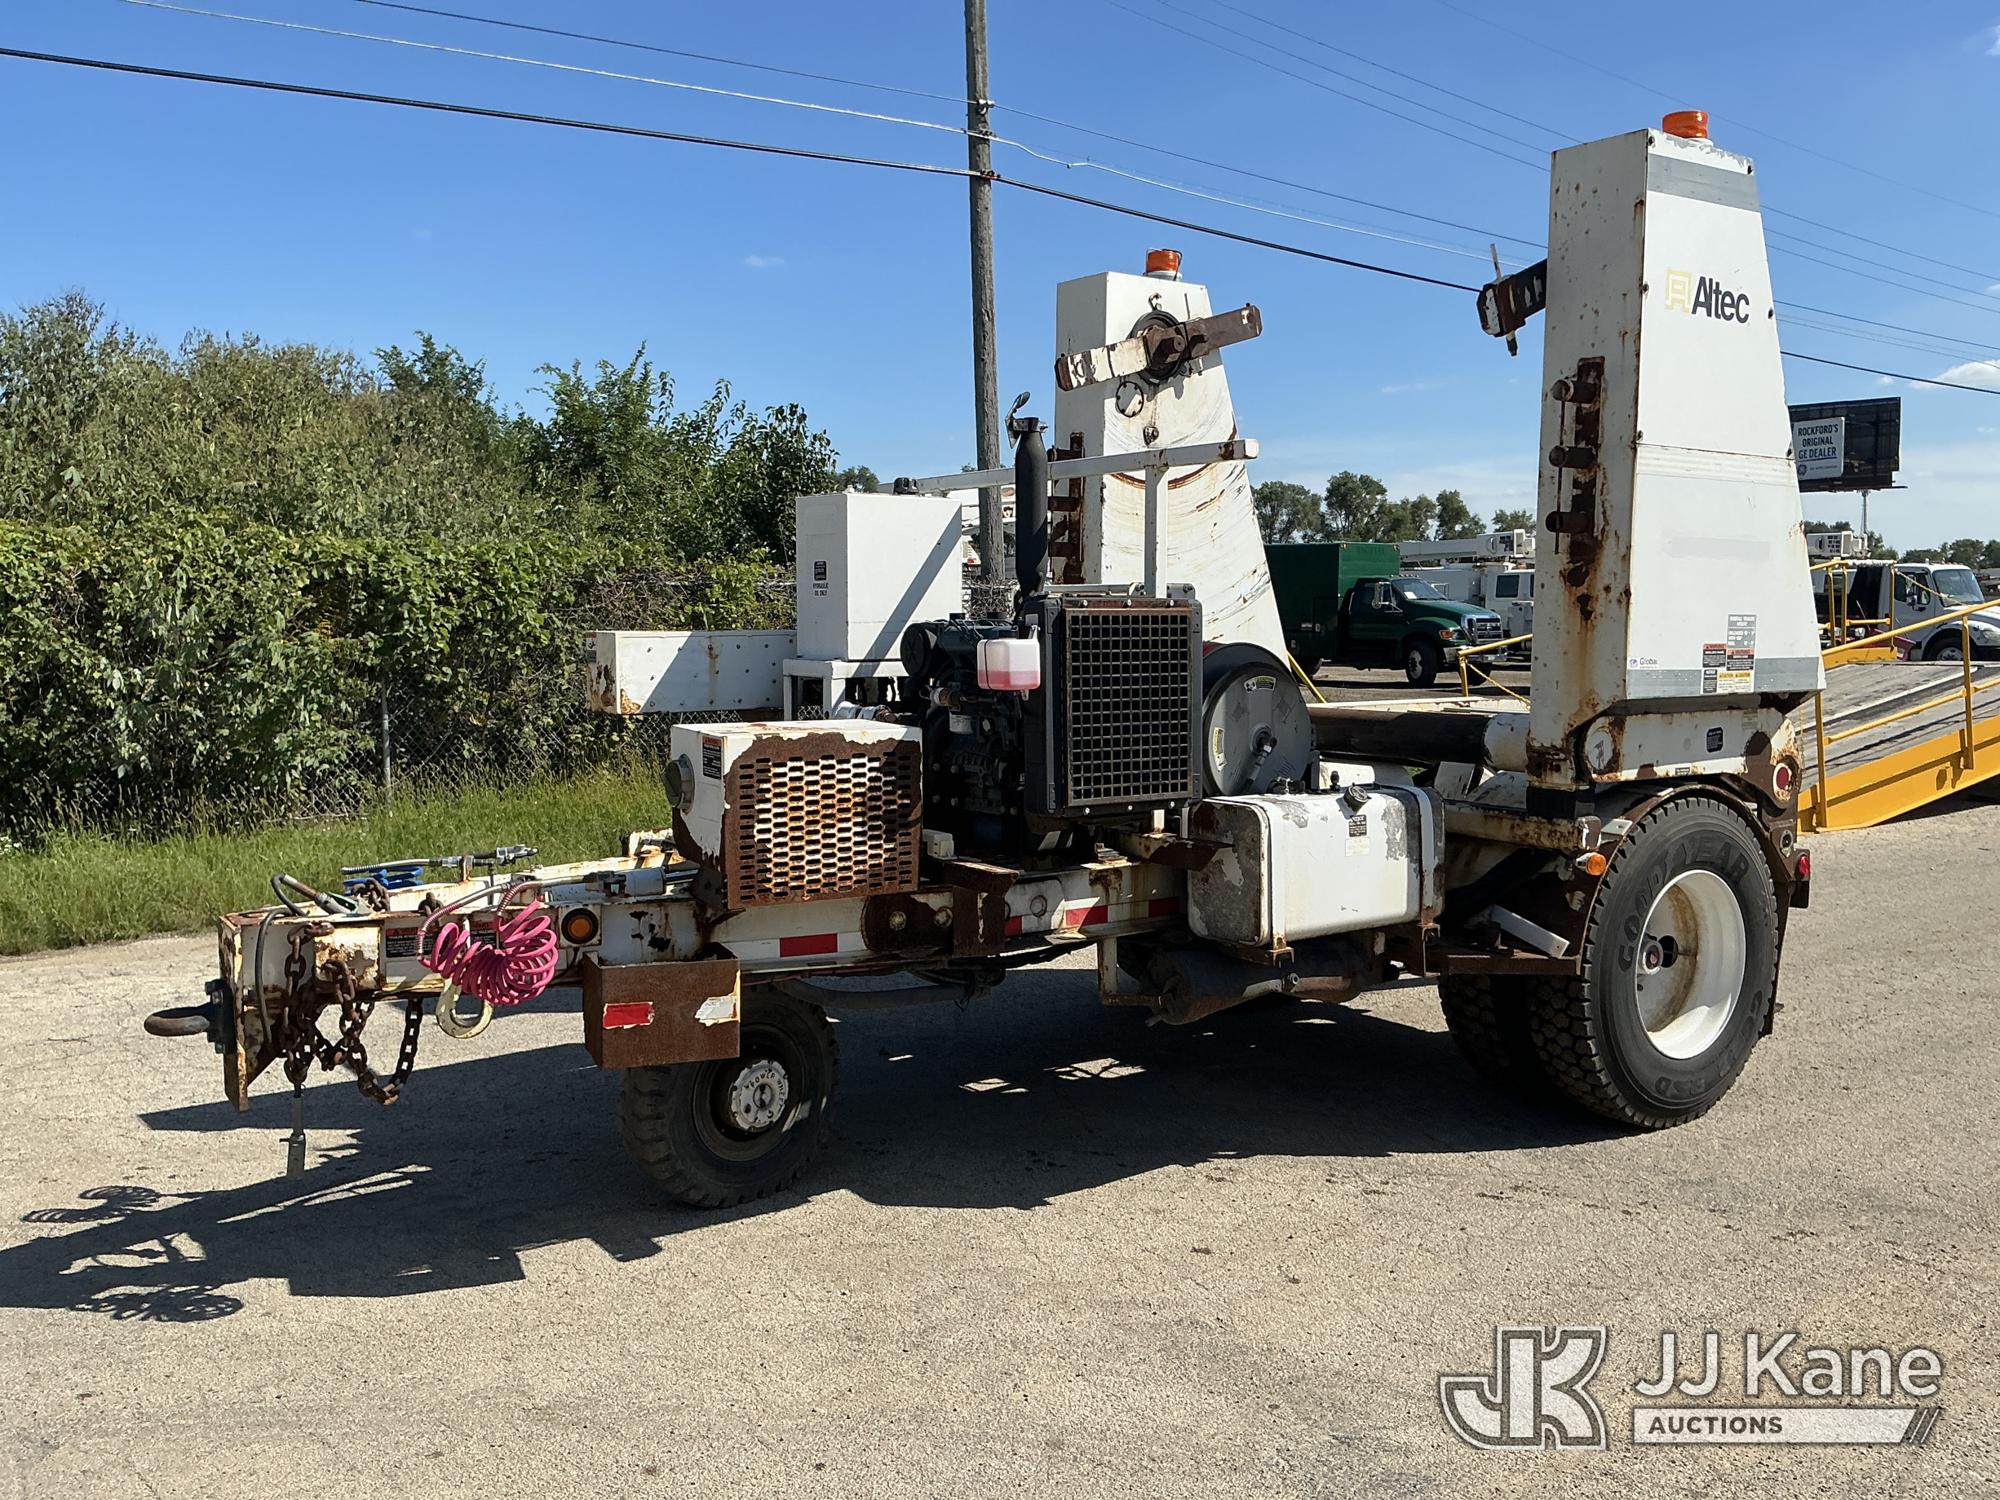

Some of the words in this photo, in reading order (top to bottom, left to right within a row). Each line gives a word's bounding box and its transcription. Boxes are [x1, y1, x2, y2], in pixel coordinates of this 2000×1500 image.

[1691, 275, 1750, 324] Altec
[1797, 424, 1839, 437] ROCKFORD'S
[1802, 436, 1834, 447] ORIGINAL
[1798, 450, 1808, 460] GE
[1808, 447, 1837, 458] DEALER
